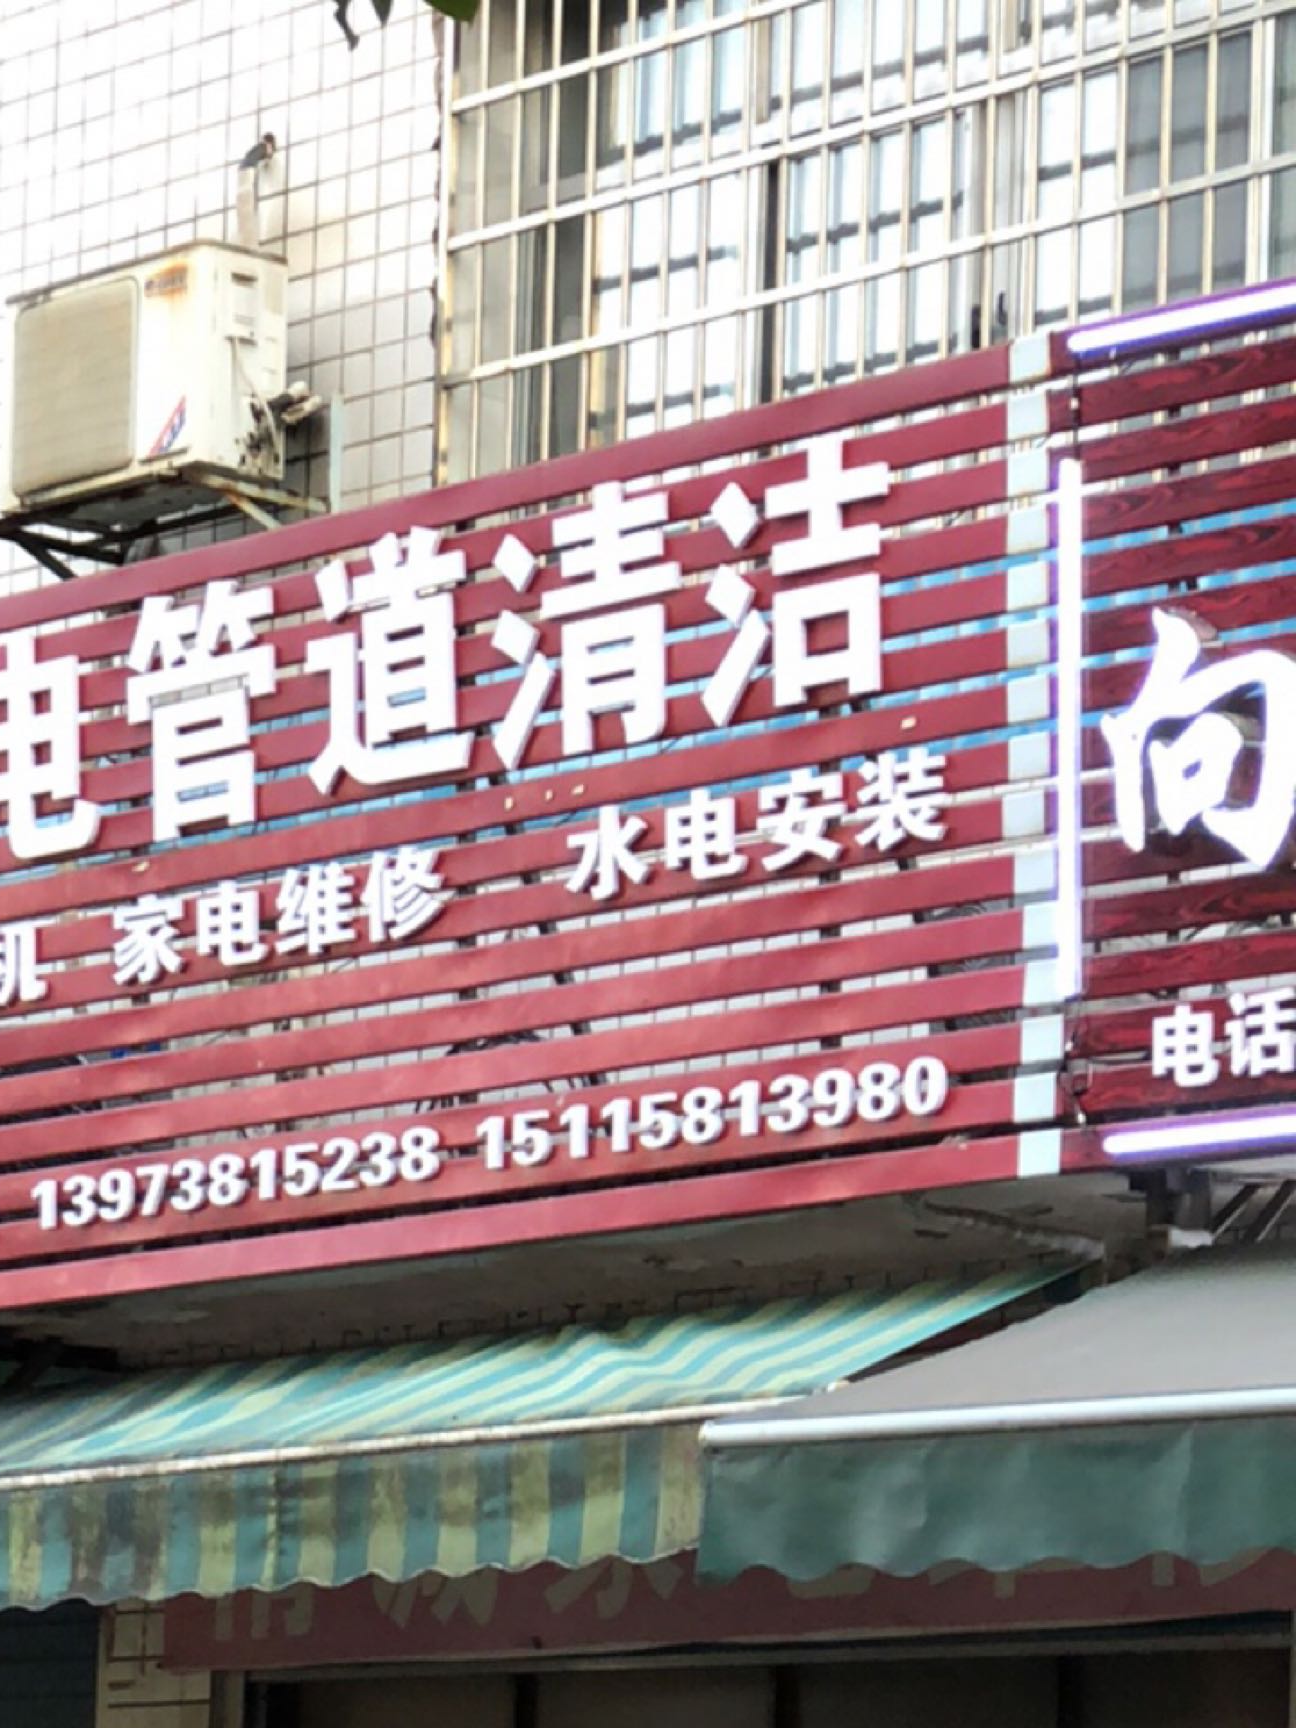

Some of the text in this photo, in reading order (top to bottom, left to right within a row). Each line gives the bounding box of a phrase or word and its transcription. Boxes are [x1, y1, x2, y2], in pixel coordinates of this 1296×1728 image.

[1100, 606, 1296, 871] 向
[565, 747, 954, 900] 水电安装
[112, 845, 453, 985] 家电维修
[1150, 989, 1296, 1088] 电话
[29, 1125, 442, 1231] 13973815238
[475, 1056, 948, 1170] 15115813980
